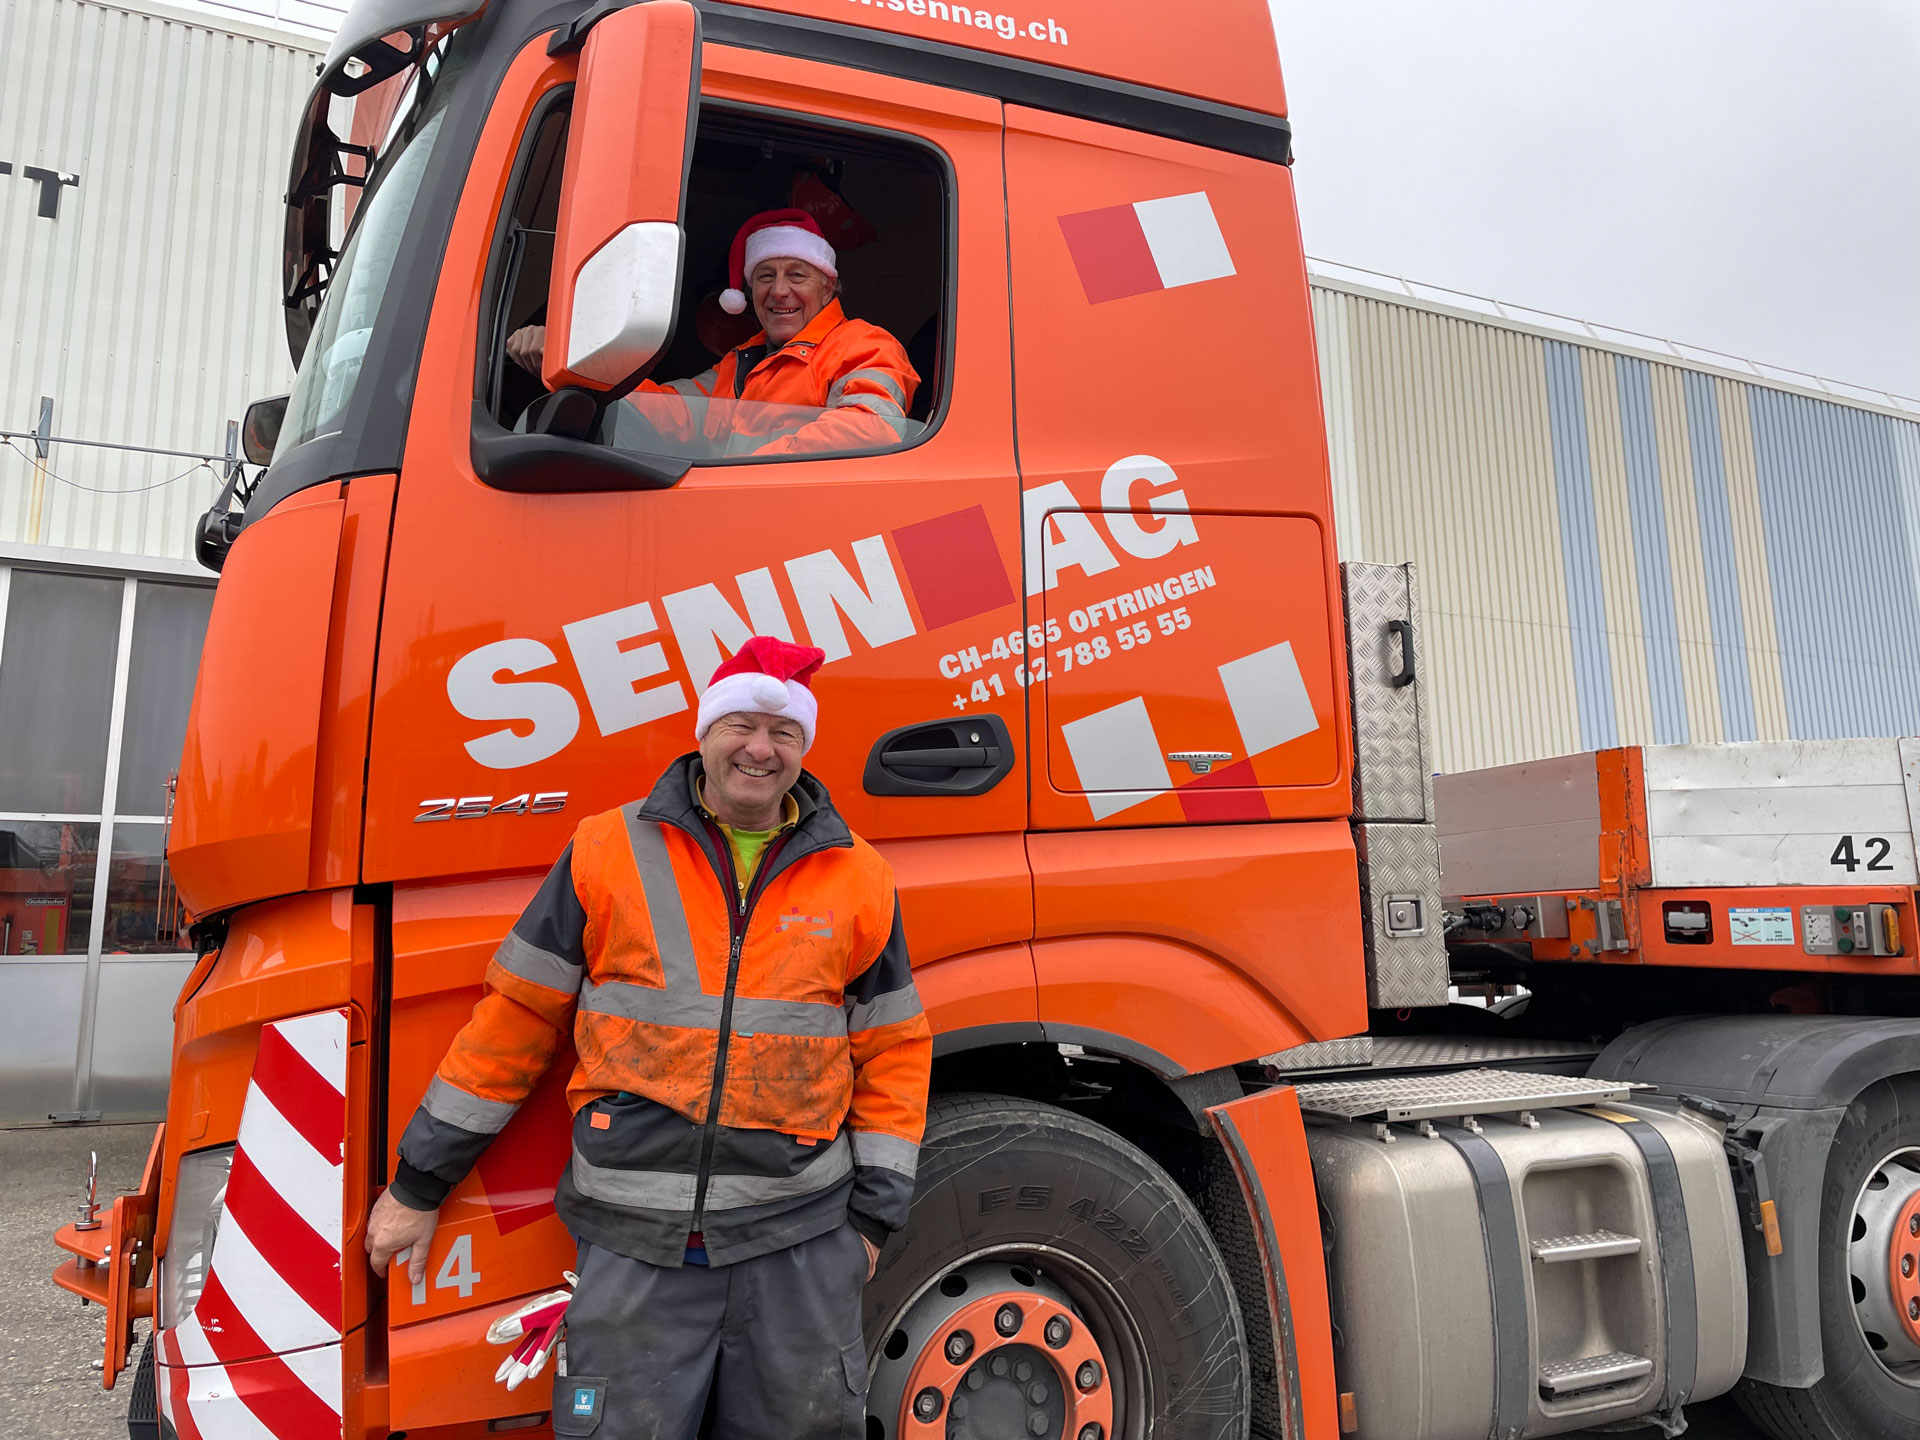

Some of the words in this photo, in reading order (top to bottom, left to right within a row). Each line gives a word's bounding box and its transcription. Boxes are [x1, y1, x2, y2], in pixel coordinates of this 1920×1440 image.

[447, 534, 916, 769] SENN
[1022, 454, 1200, 598] AG
[938, 618, 1062, 679] CH-4665
[1068, 565, 1217, 634] OFTRINGEN
[1014, 656, 1053, 688] 62
[1056, 636, 1112, 672] 788
[1116, 621, 1152, 651] 55
[1156, 606, 1192, 636] 55
[413, 791, 569, 823] 2545
[1830, 835, 1894, 872] 42
[979, 1184, 1053, 1216] FS
[1067, 1197, 1151, 1262] 422
